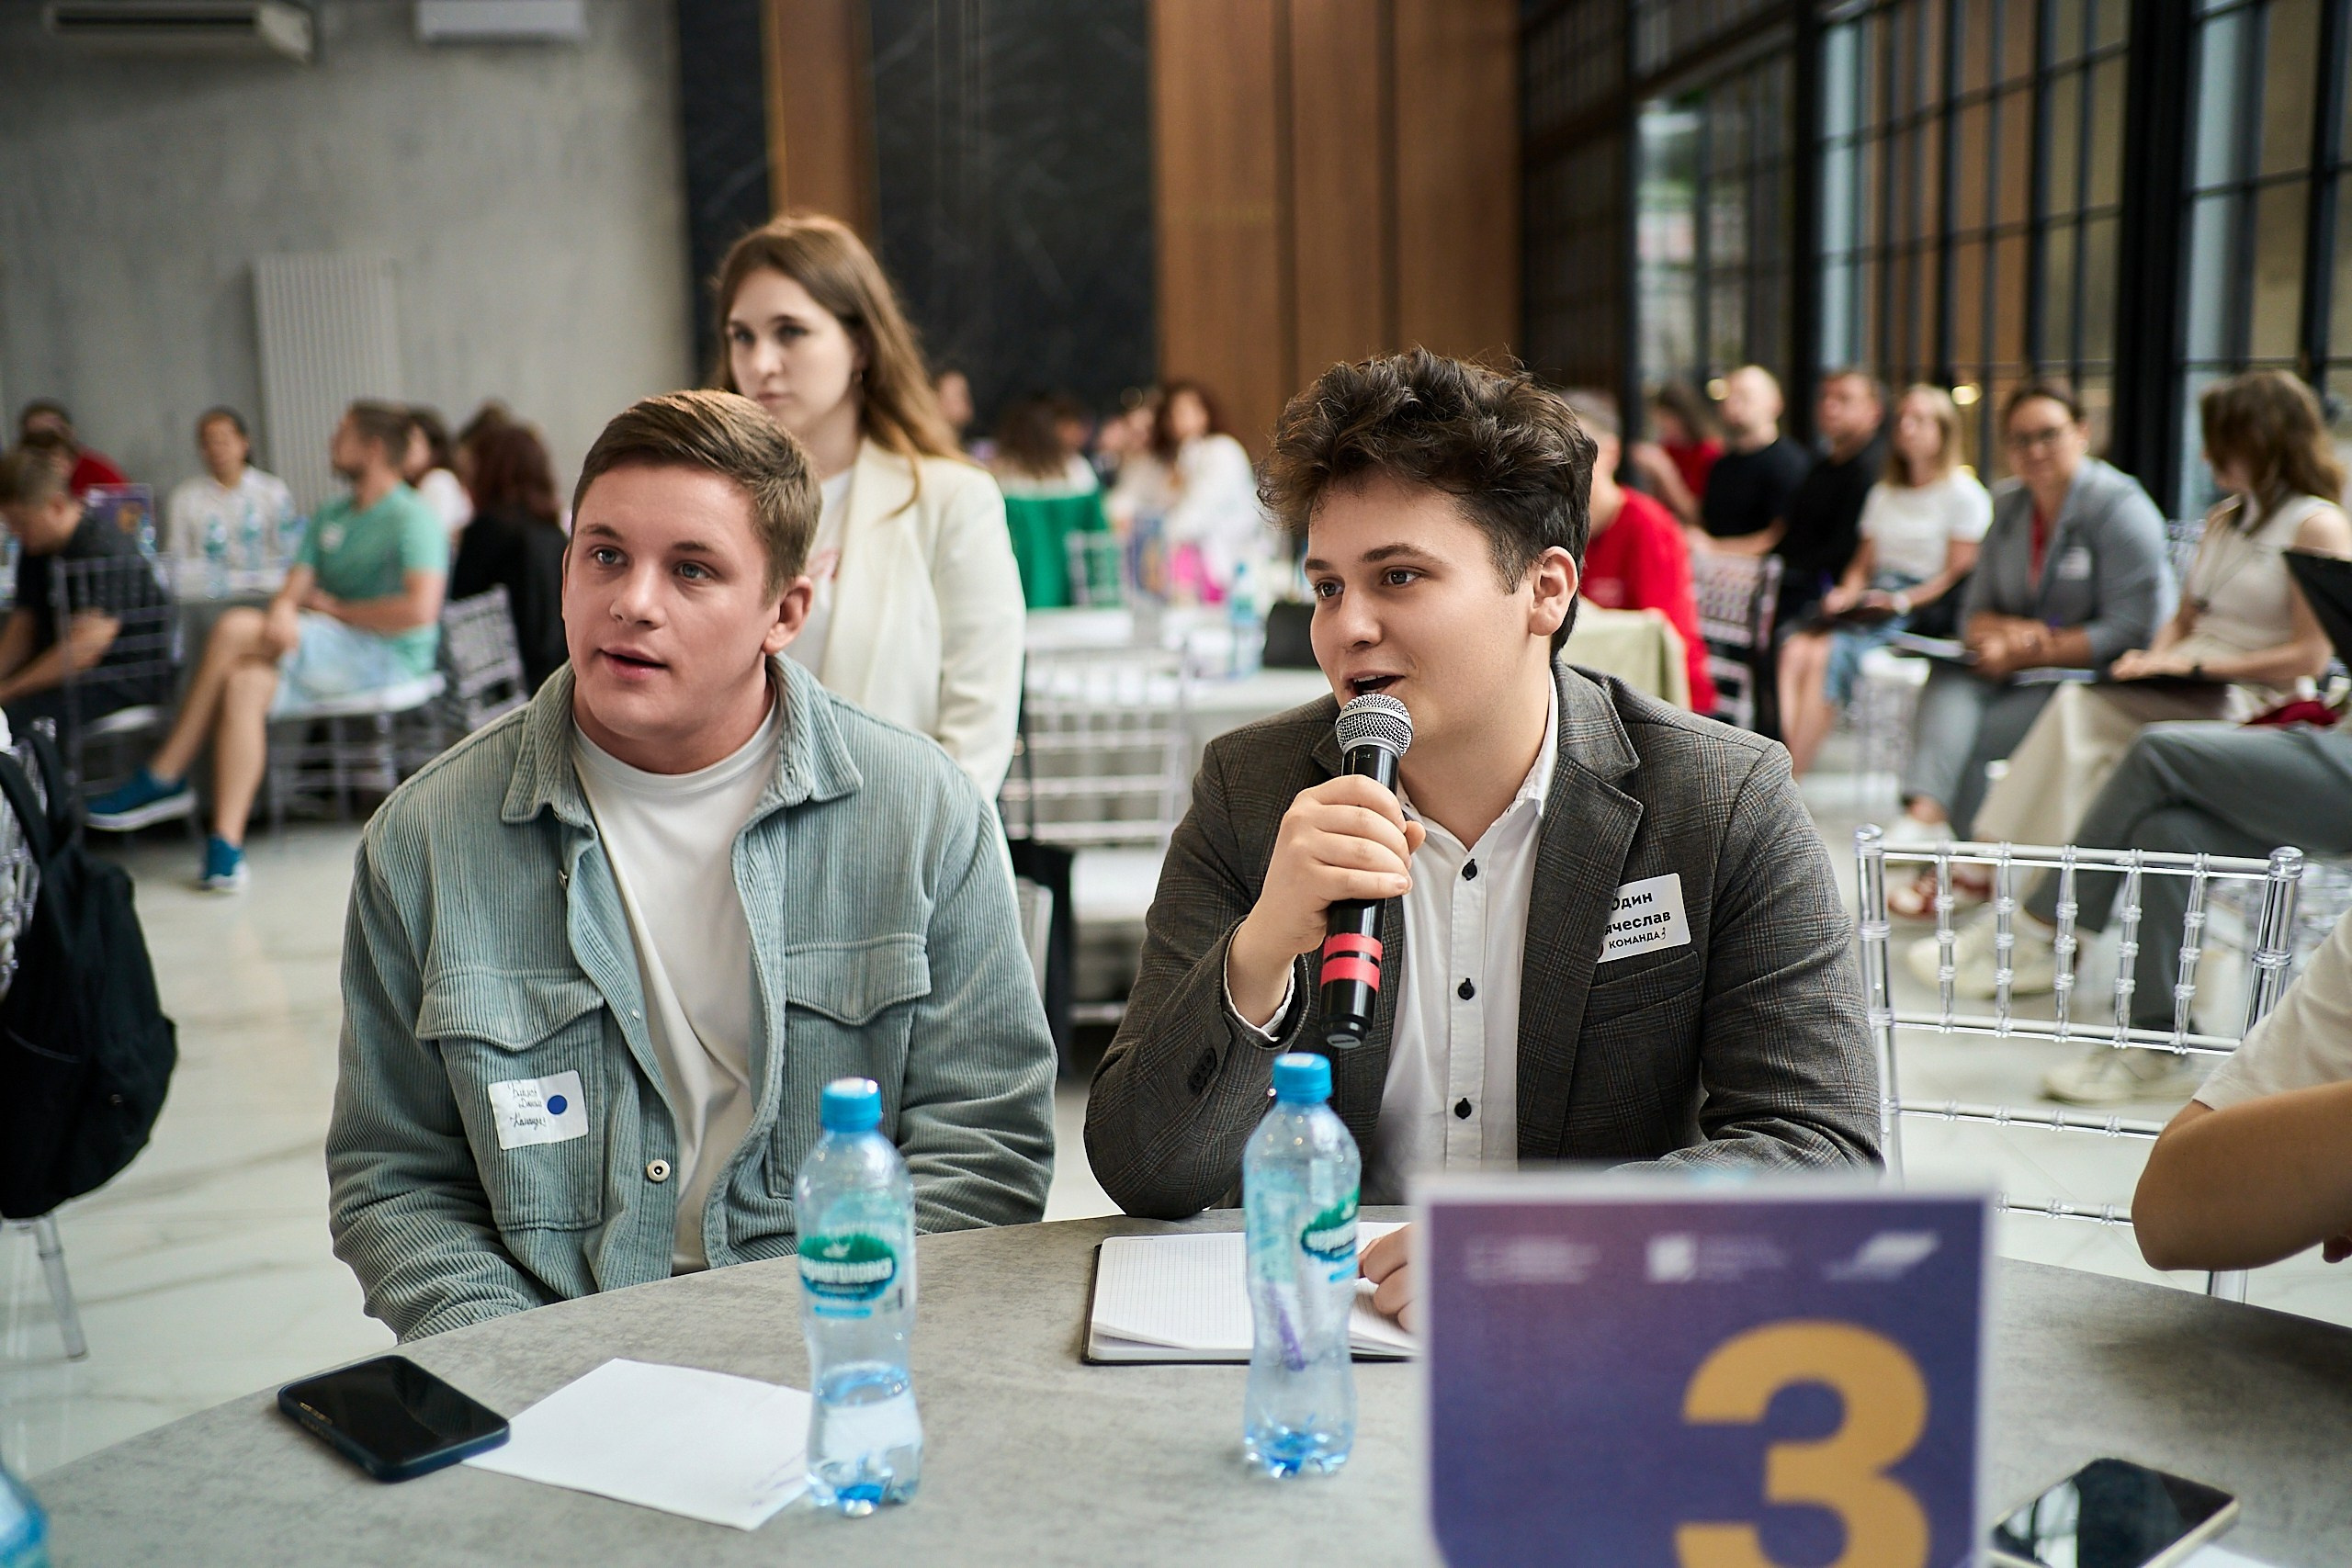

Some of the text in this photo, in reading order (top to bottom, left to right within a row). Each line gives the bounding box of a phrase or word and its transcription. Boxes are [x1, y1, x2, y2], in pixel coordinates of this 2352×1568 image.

[1605, 911, 1671, 936] ячеслав
[1609, 931, 1660, 950] КОМАНДА
[1676, 1318, 1928, 1568] 3
